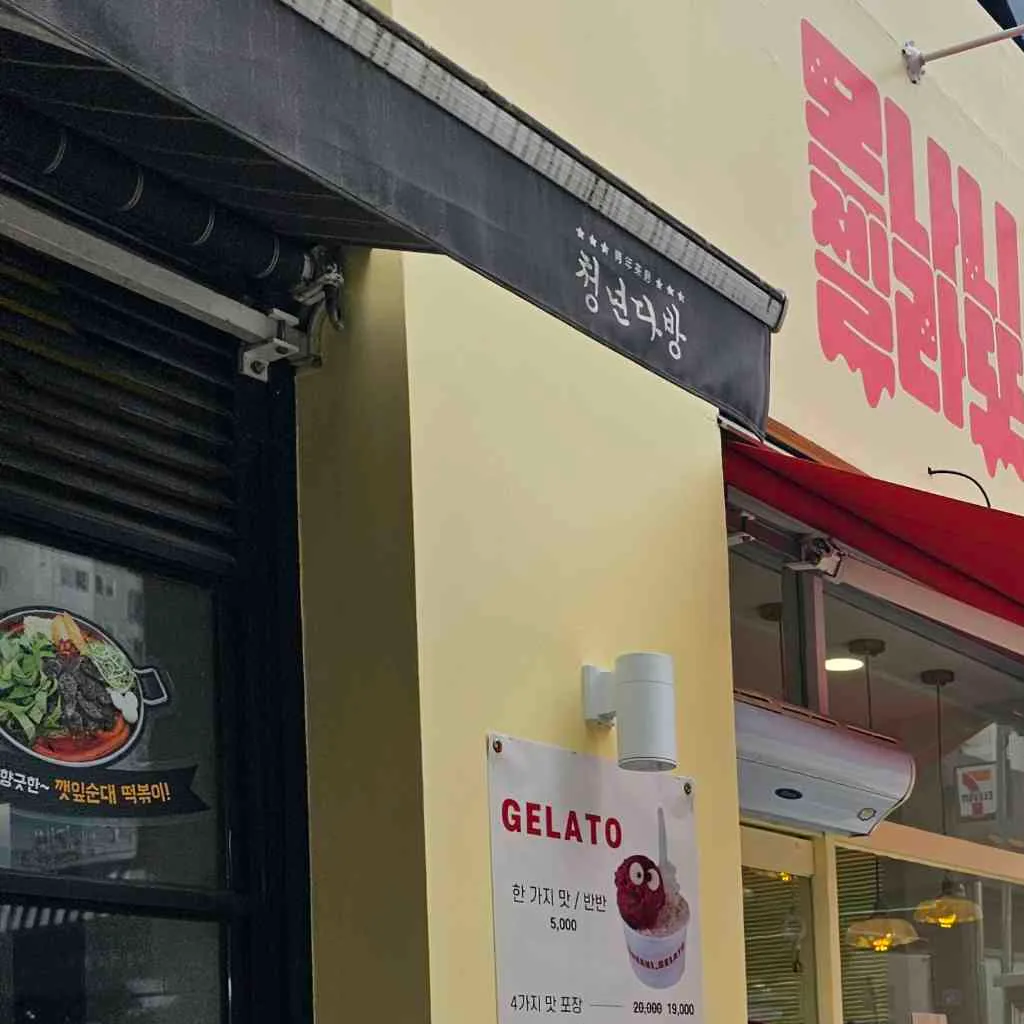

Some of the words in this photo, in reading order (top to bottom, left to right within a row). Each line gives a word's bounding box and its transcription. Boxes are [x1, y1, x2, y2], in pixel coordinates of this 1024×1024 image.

[575, 249, 688, 361] 청년다방
[54, 778, 118, 805] 깻잎순대
[121, 781, 171, 804] 떡볶이!
[501, 798, 623, 849] GELATO
[512, 883, 526, 904] 한
[530, 886, 554, 906] 가지
[559, 889, 571, 909] 맛
[584, 893, 607, 912] 반반
[550, 917, 577, 932] 5,000
[511, 995, 541, 1012] 4가지
[545, 995, 557, 1013] 맛
[560, 996, 583, 1014] 포장
[667, 1003, 695, 1016] 19,000
